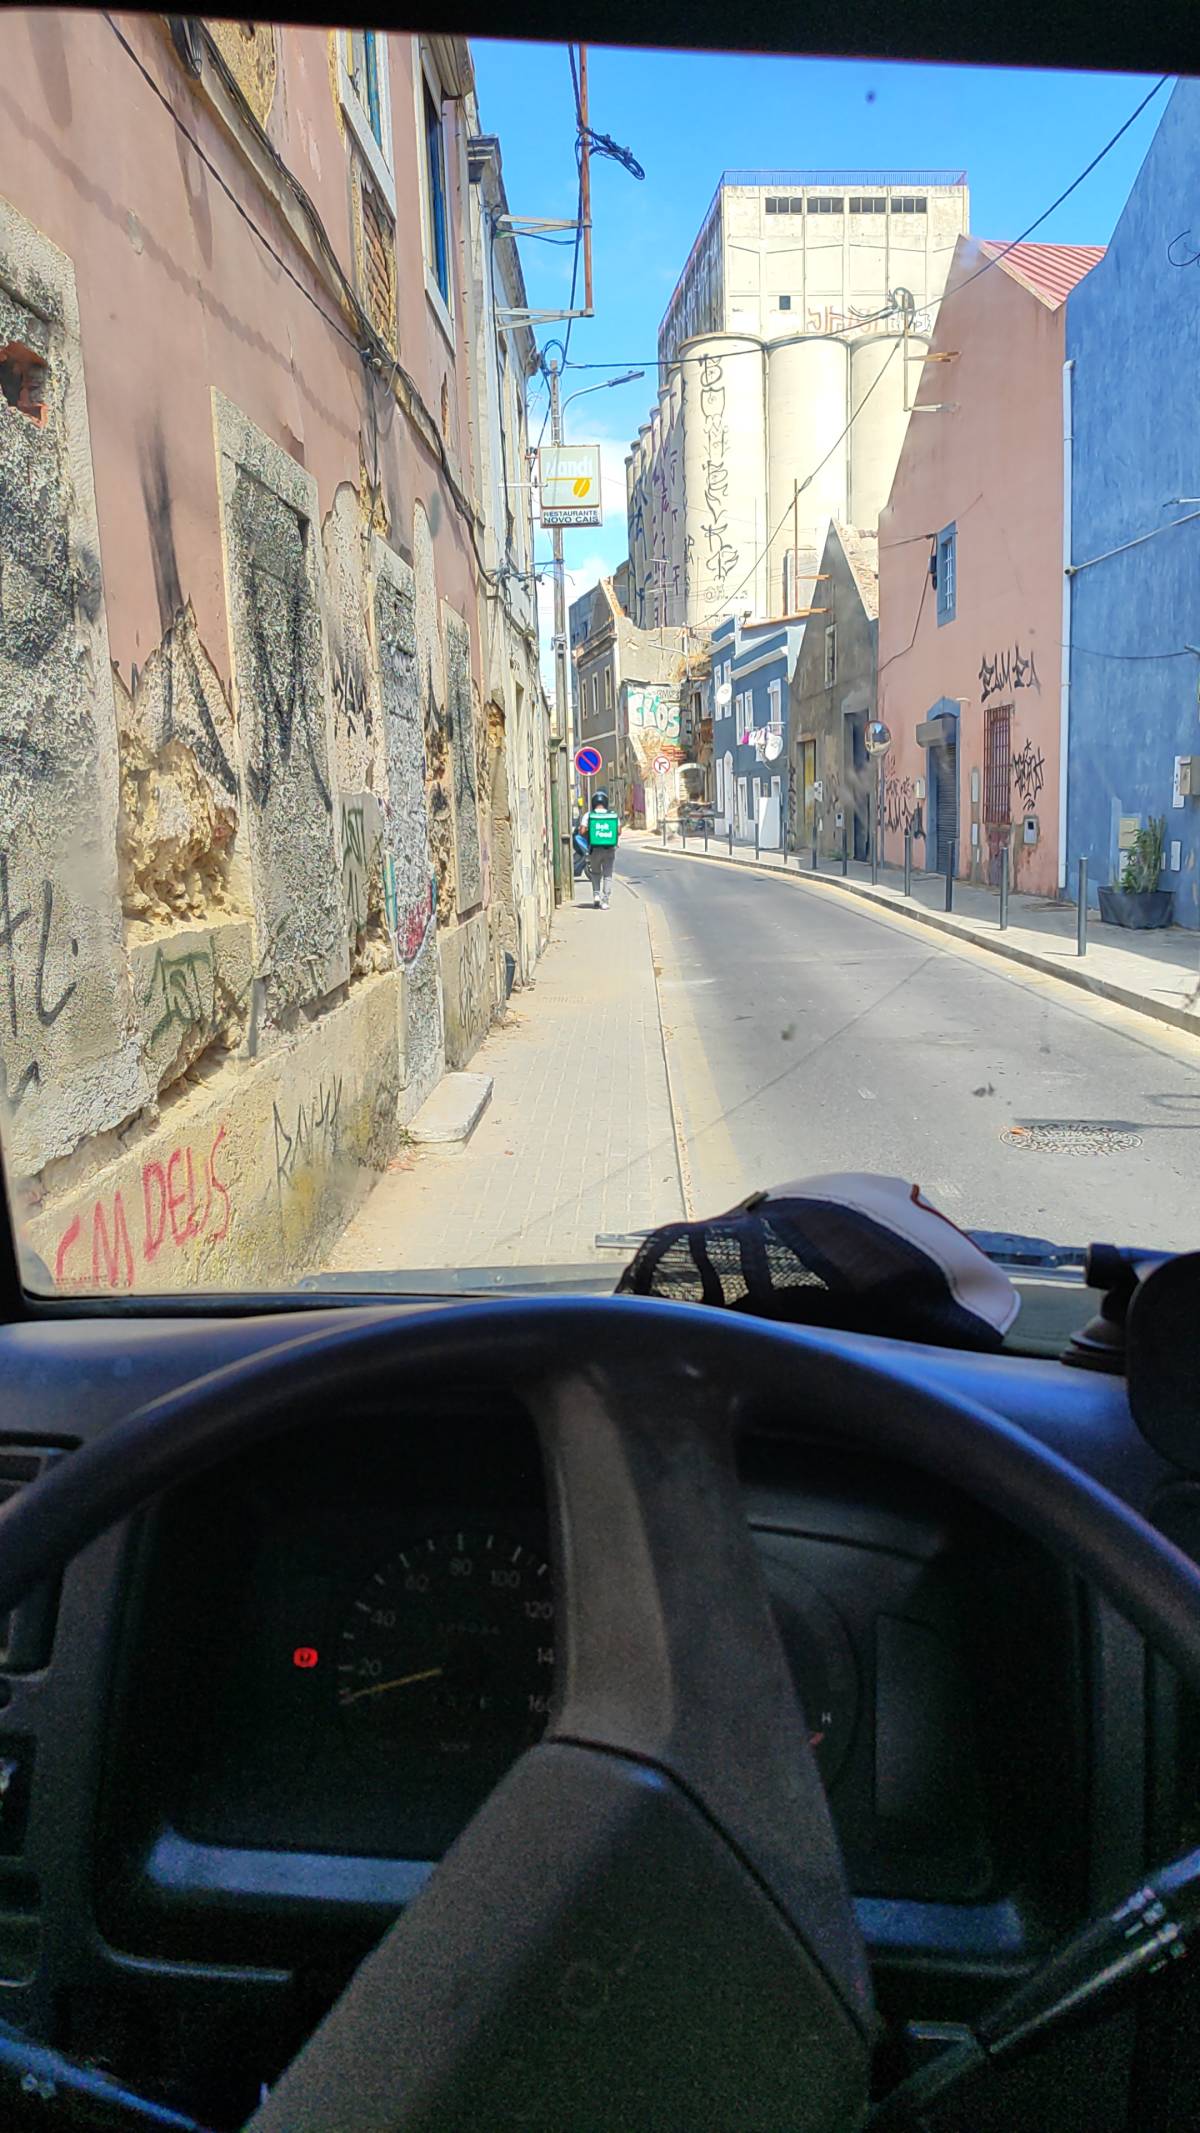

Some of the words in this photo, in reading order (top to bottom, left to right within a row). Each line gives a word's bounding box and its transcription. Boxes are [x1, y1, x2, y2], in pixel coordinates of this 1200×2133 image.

[491, 1570, 521, 1589] 100
[371, 1610, 396, 1628] 40
[524, 1601, 554, 1620] 120
[358, 1657, 382, 1676] 20
